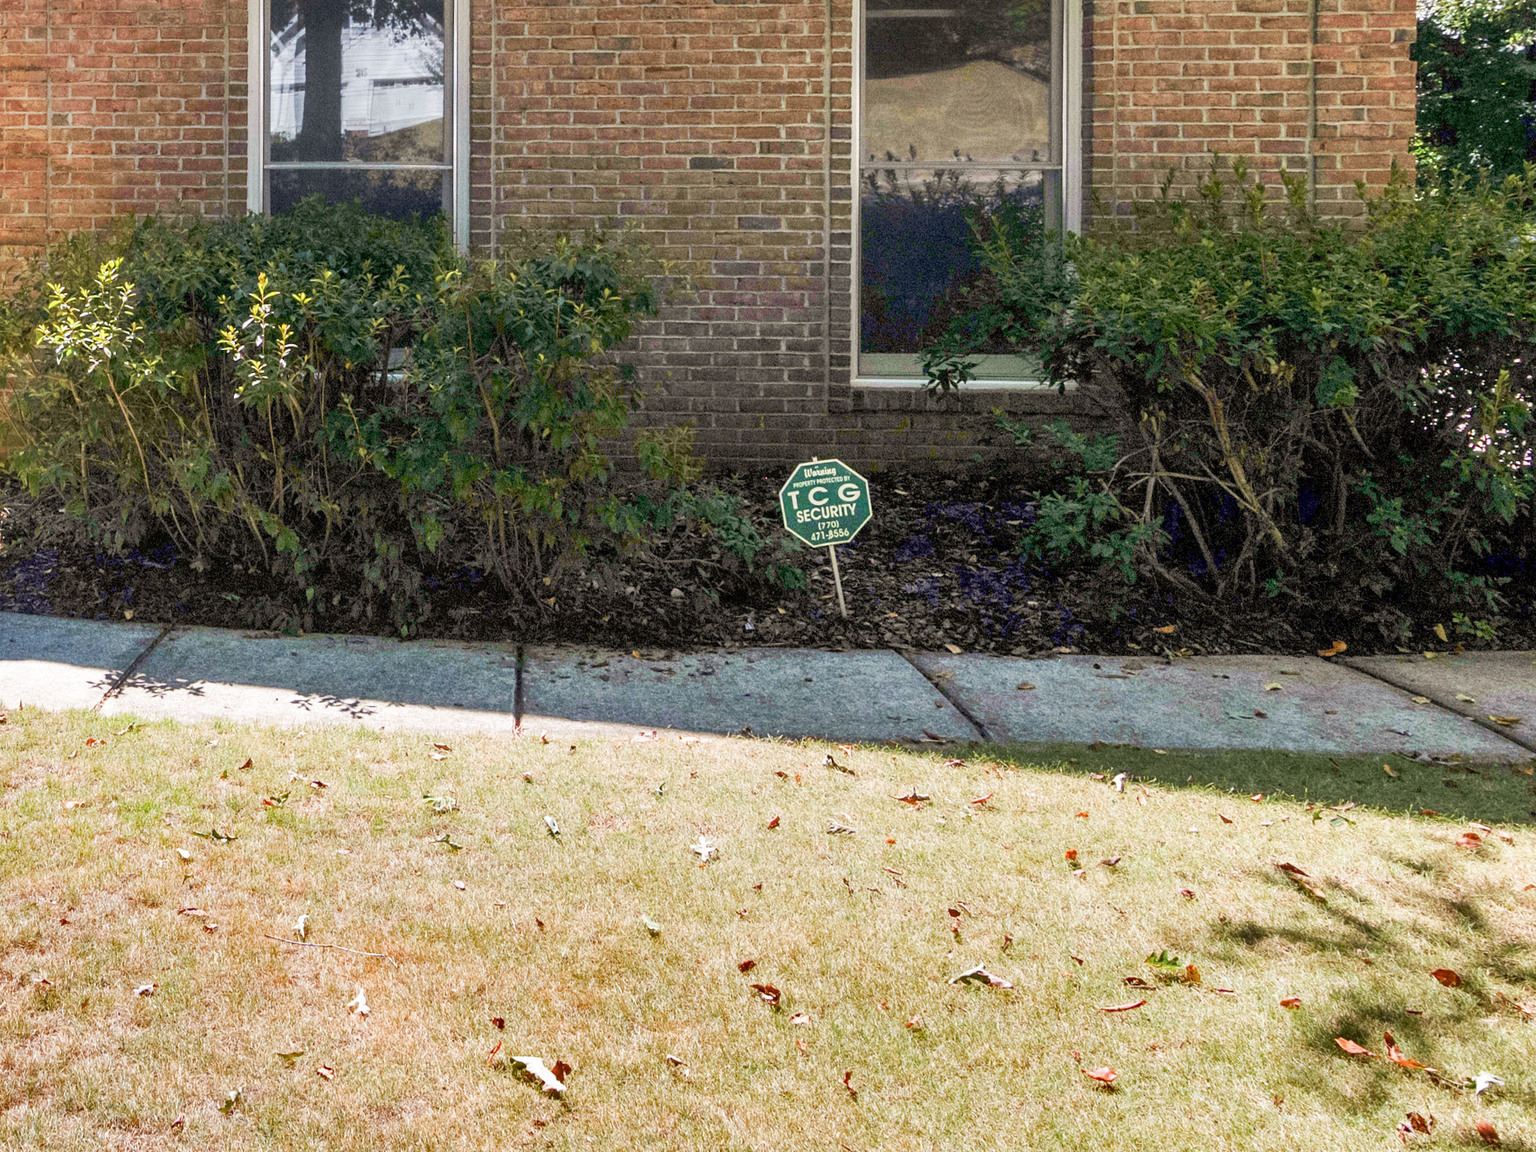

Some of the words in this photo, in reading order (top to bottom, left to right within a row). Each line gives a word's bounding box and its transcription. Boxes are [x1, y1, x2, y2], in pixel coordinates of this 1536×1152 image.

[804, 465, 837, 478] Warning
[793, 479, 816, 488] PROPERTY
[816, 476, 843, 485] PROTECTED
[796, 503, 857, 523] SECURITY
[818, 520, 840, 530] (770)
[811, 528, 850, 541] 471-8556
